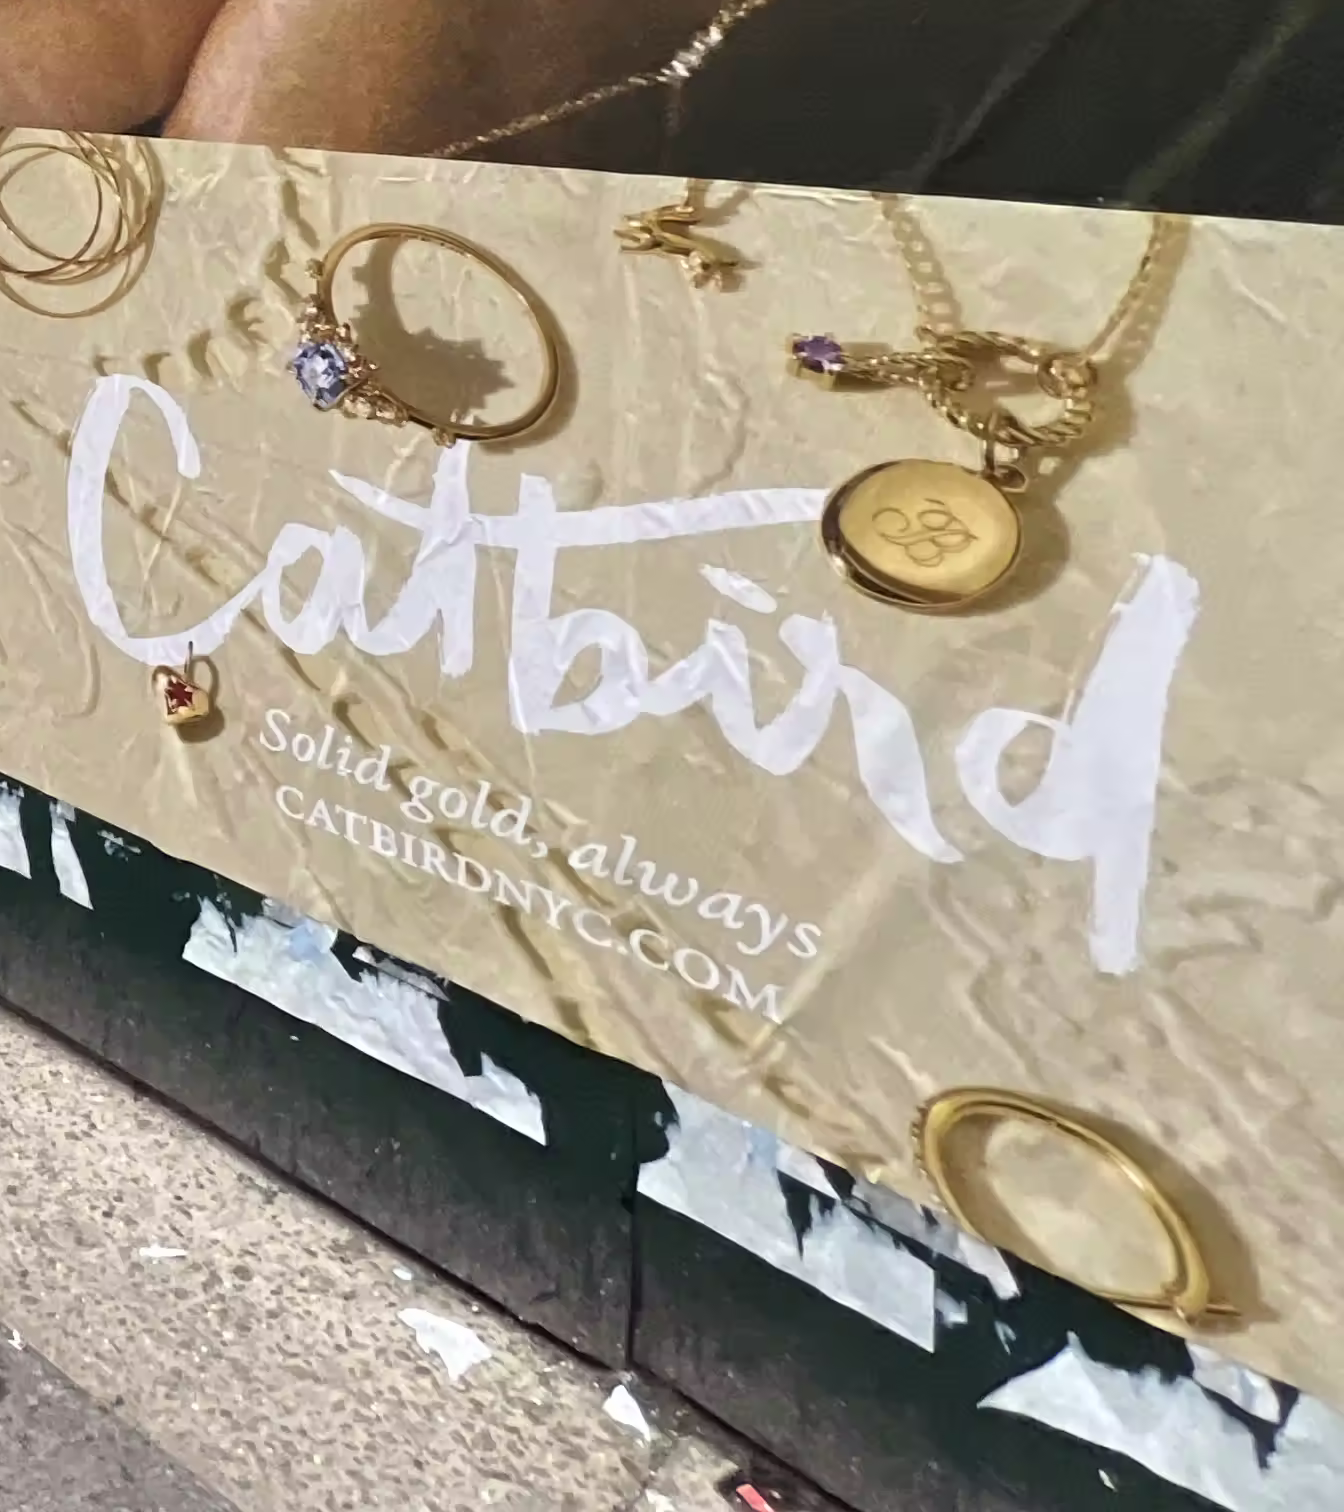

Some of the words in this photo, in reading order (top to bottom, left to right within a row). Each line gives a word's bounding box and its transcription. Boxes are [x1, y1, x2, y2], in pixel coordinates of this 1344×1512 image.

[68, 374, 1201, 974] Catbird
[260, 708, 392, 791] Solid
[399, 775, 548, 859] gold,
[568, 834, 822, 959] always
[275, 784, 784, 1025] CATBIRDNYC.COM
